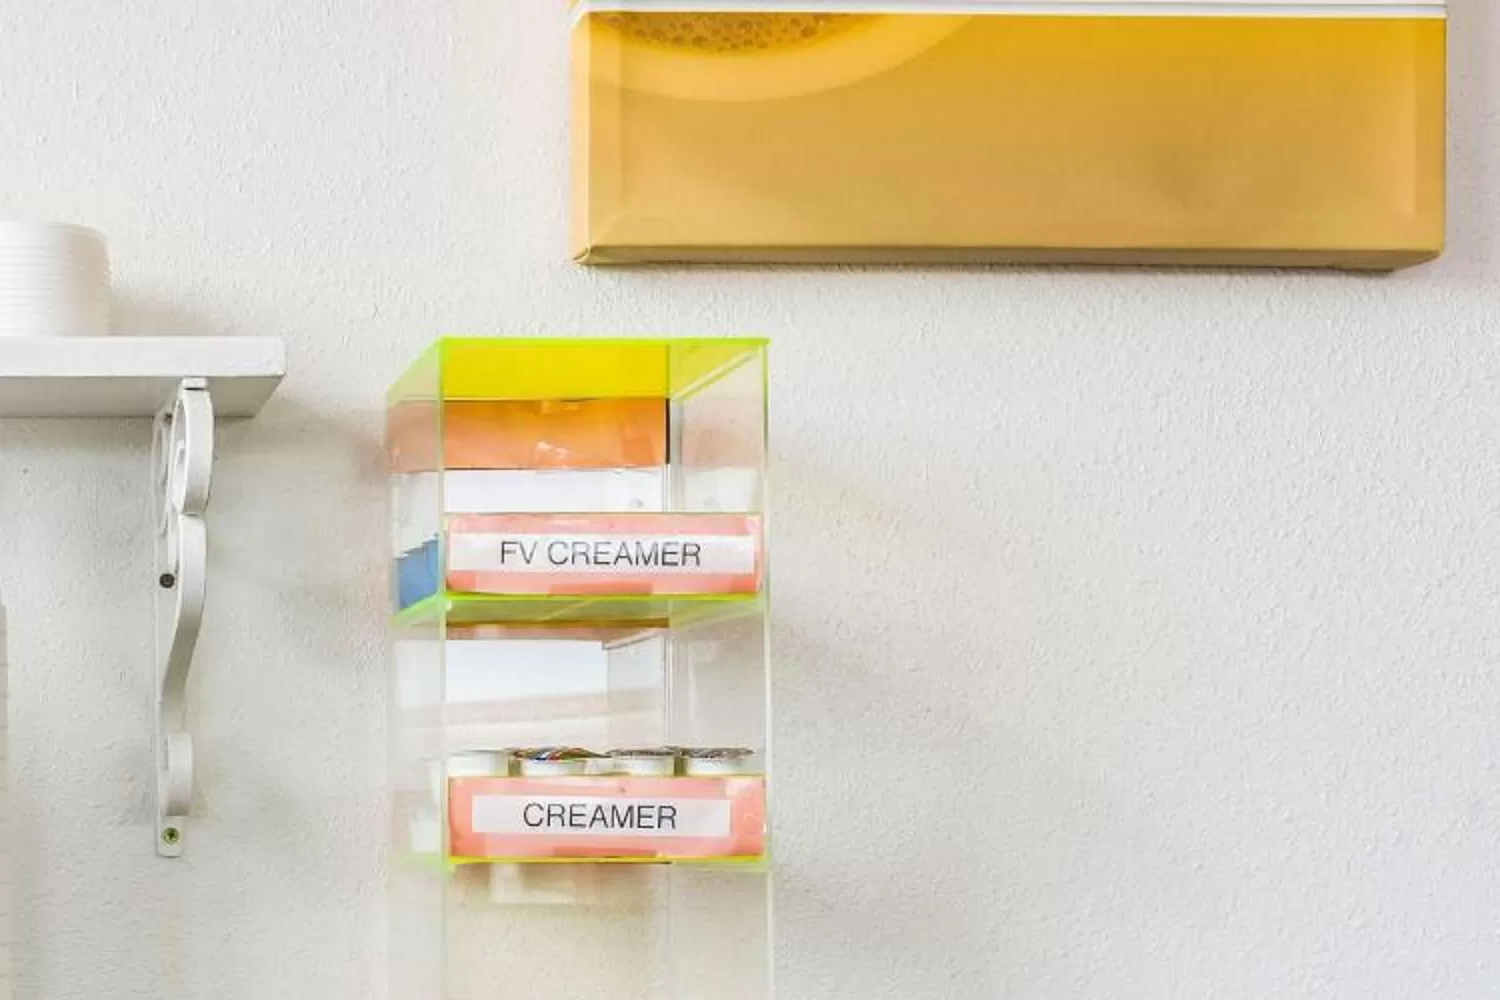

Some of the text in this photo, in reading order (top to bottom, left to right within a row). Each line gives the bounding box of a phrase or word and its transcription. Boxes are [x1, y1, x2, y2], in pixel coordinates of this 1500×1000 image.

[500, 541, 701, 567] FV CREAMER
[523, 802, 677, 829] CREAMER
